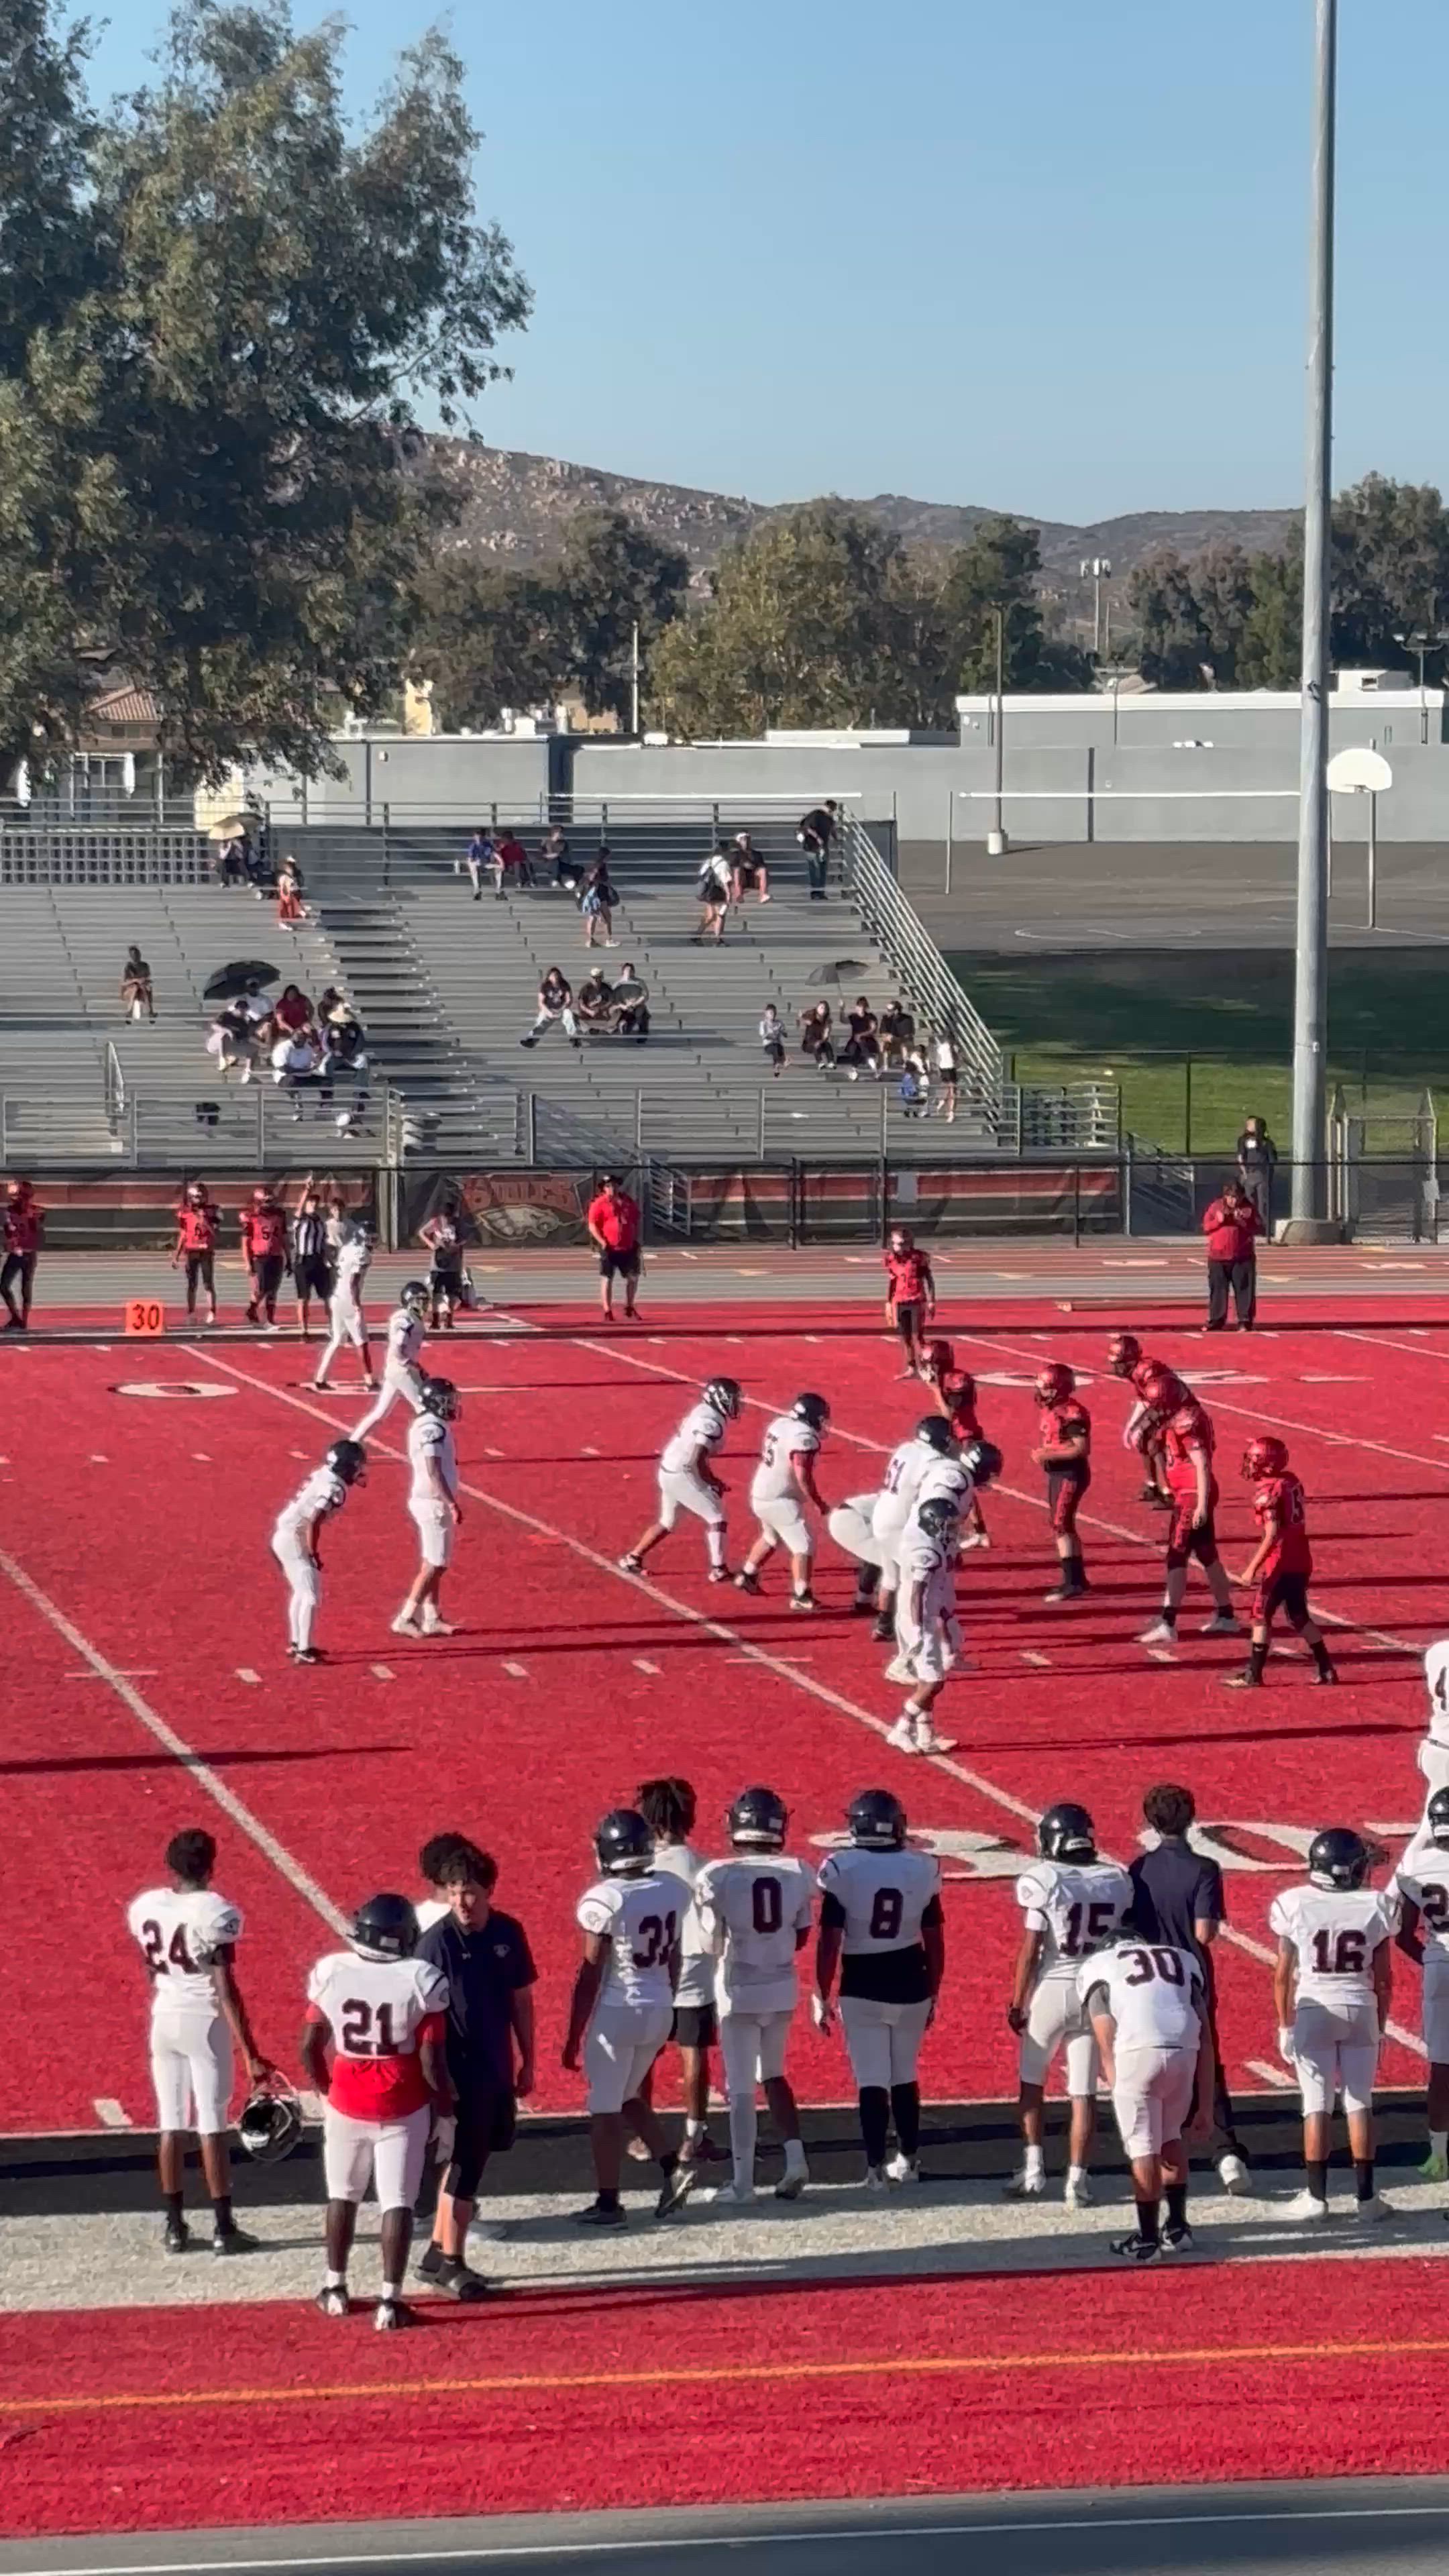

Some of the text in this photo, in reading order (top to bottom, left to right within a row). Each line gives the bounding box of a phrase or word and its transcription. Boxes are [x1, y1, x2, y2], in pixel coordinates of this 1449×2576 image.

[132, 1304, 160, 1330] 30
[751, 1876, 784, 1934] 0
[869, 1887, 904, 1939] 8
[1058, 1902, 1116, 1957] 15
[142, 1919, 199, 1974] 24
[633, 1909, 678, 1970] 31
[1116, 1946, 1186, 1988] 30
[1311, 1929, 1365, 1974] 16
[341, 1997, 396, 2057] 21
